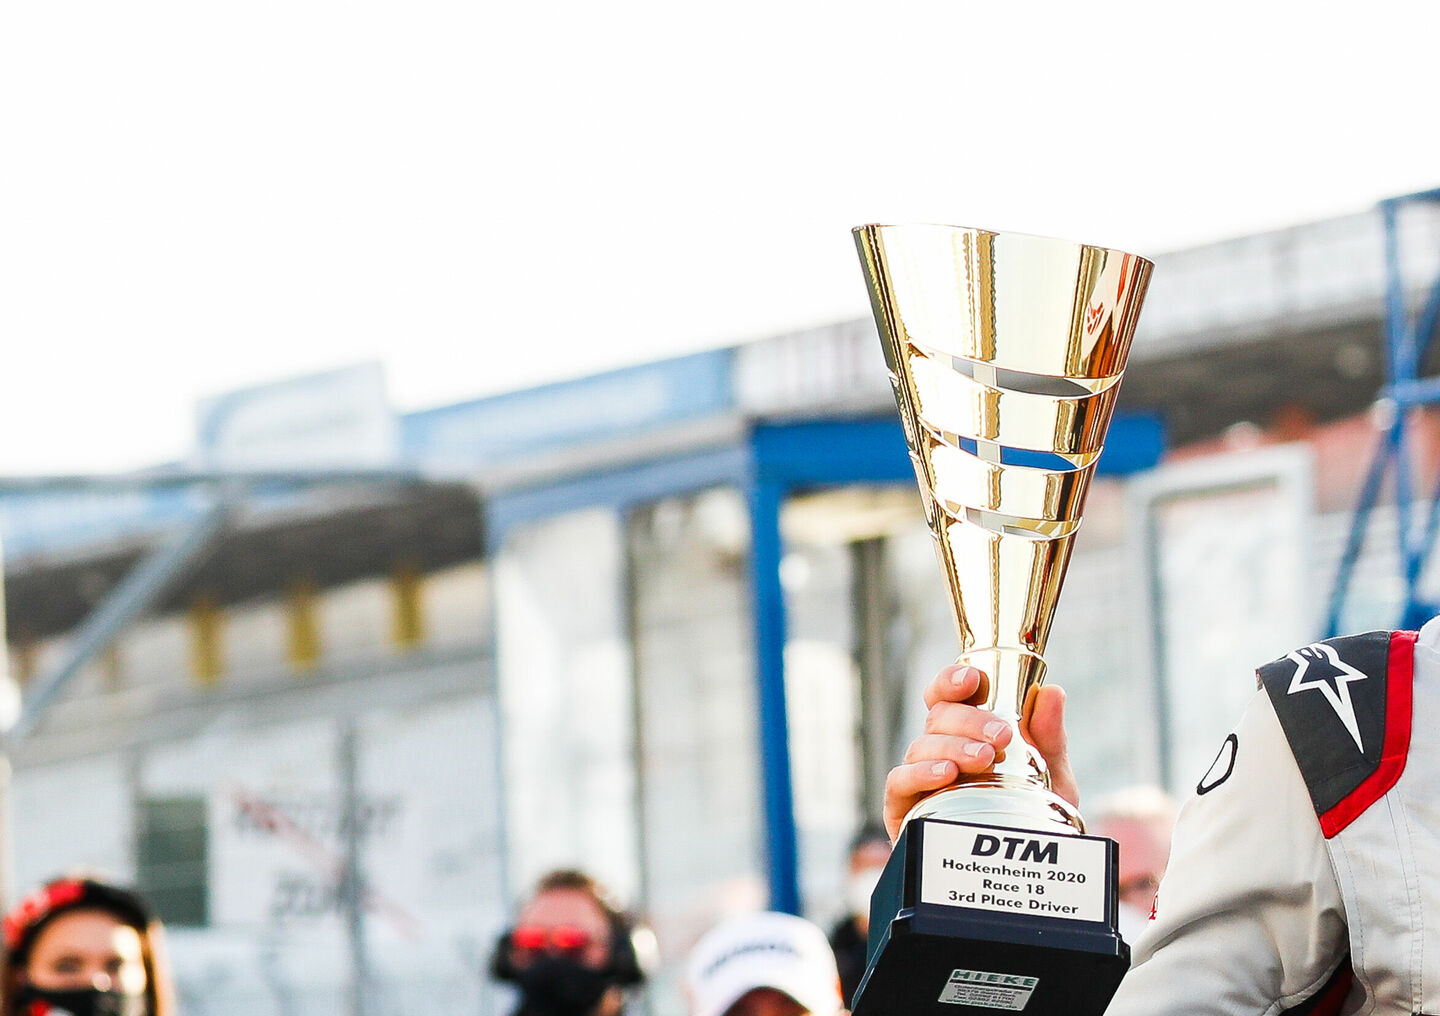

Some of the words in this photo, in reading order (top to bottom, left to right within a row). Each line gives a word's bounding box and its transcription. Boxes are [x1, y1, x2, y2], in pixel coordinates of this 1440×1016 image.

[971, 834, 1059, 865] DTM
[942, 858, 1041, 879] Hockenheim
[1047, 870, 1086, 884] 2020
[983, 879, 1020, 893] Race
[1027, 884, 1045, 895] 18
[948, 890, 976, 903] 3rd
[981, 894, 1023, 908] Place
[1029, 900, 1079, 914] Driver
[953, 971, 1036, 986] HIEKE
